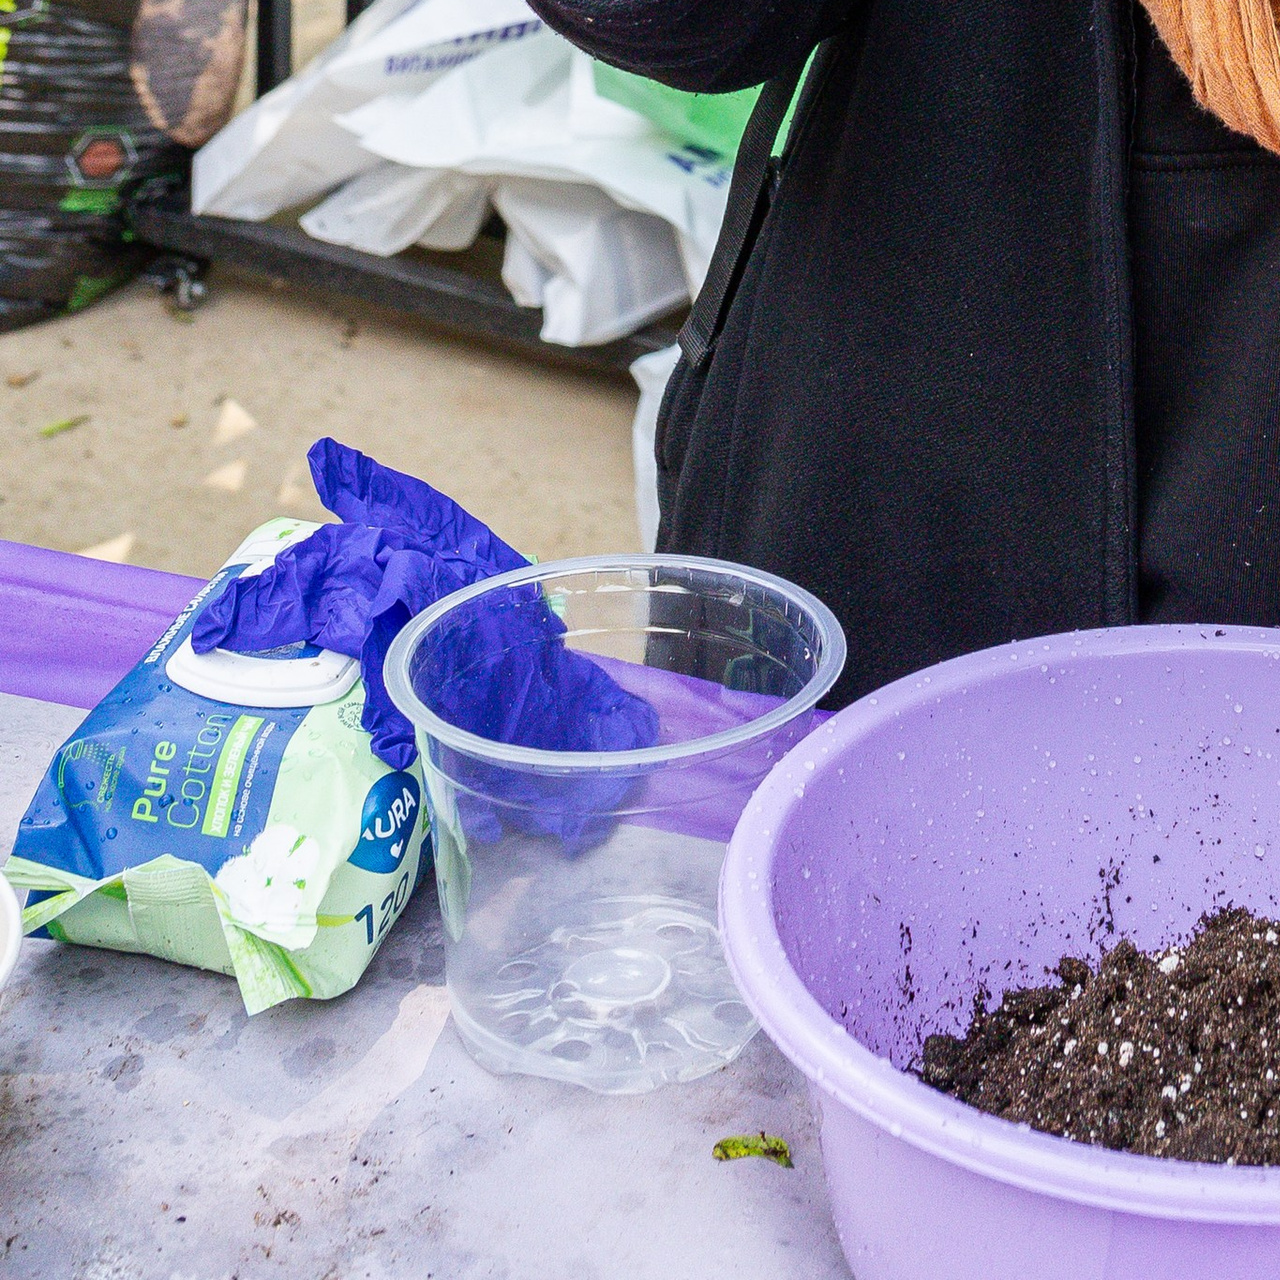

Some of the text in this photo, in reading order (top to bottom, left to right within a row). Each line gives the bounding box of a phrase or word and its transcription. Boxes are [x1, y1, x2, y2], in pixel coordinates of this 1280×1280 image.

[131, 740, 177, 824] Pure
[167, 713, 233, 829] Cotton
[246, 738, 265, 788] очищенной
[209, 787, 231, 833] ХЛОПОК
[221, 777, 232, 789] И
[233, 824, 242, 837] на
[236, 789, 250, 824] основе
